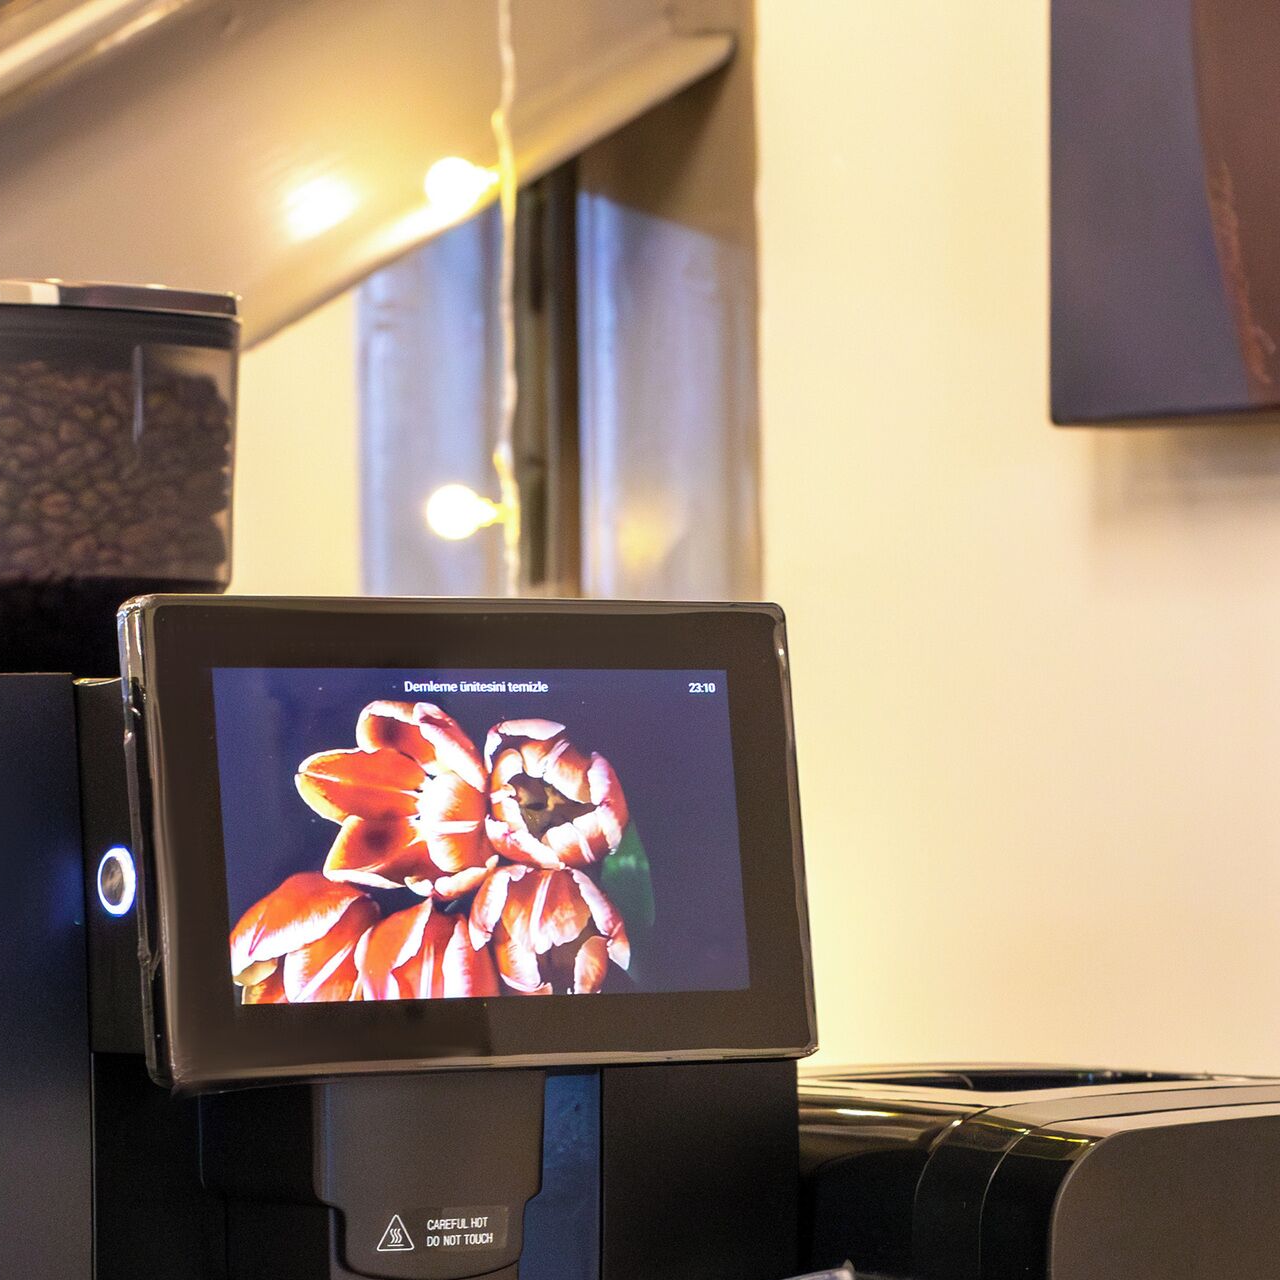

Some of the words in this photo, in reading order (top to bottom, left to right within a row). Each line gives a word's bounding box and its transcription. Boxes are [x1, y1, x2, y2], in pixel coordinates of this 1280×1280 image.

[404, 680, 458, 693] Demleme
[460, 680, 506, 693] ünitesini
[507, 680, 549, 693] temizle
[688, 682, 716, 693] 23:10
[426, 1218, 470, 1231] CAREFUL
[471, 1216, 489, 1229] HOT
[426, 1235, 440, 1247] DO
[443, 1234, 462, 1246] NOT
[463, 1232, 494, 1246] TOUCH
